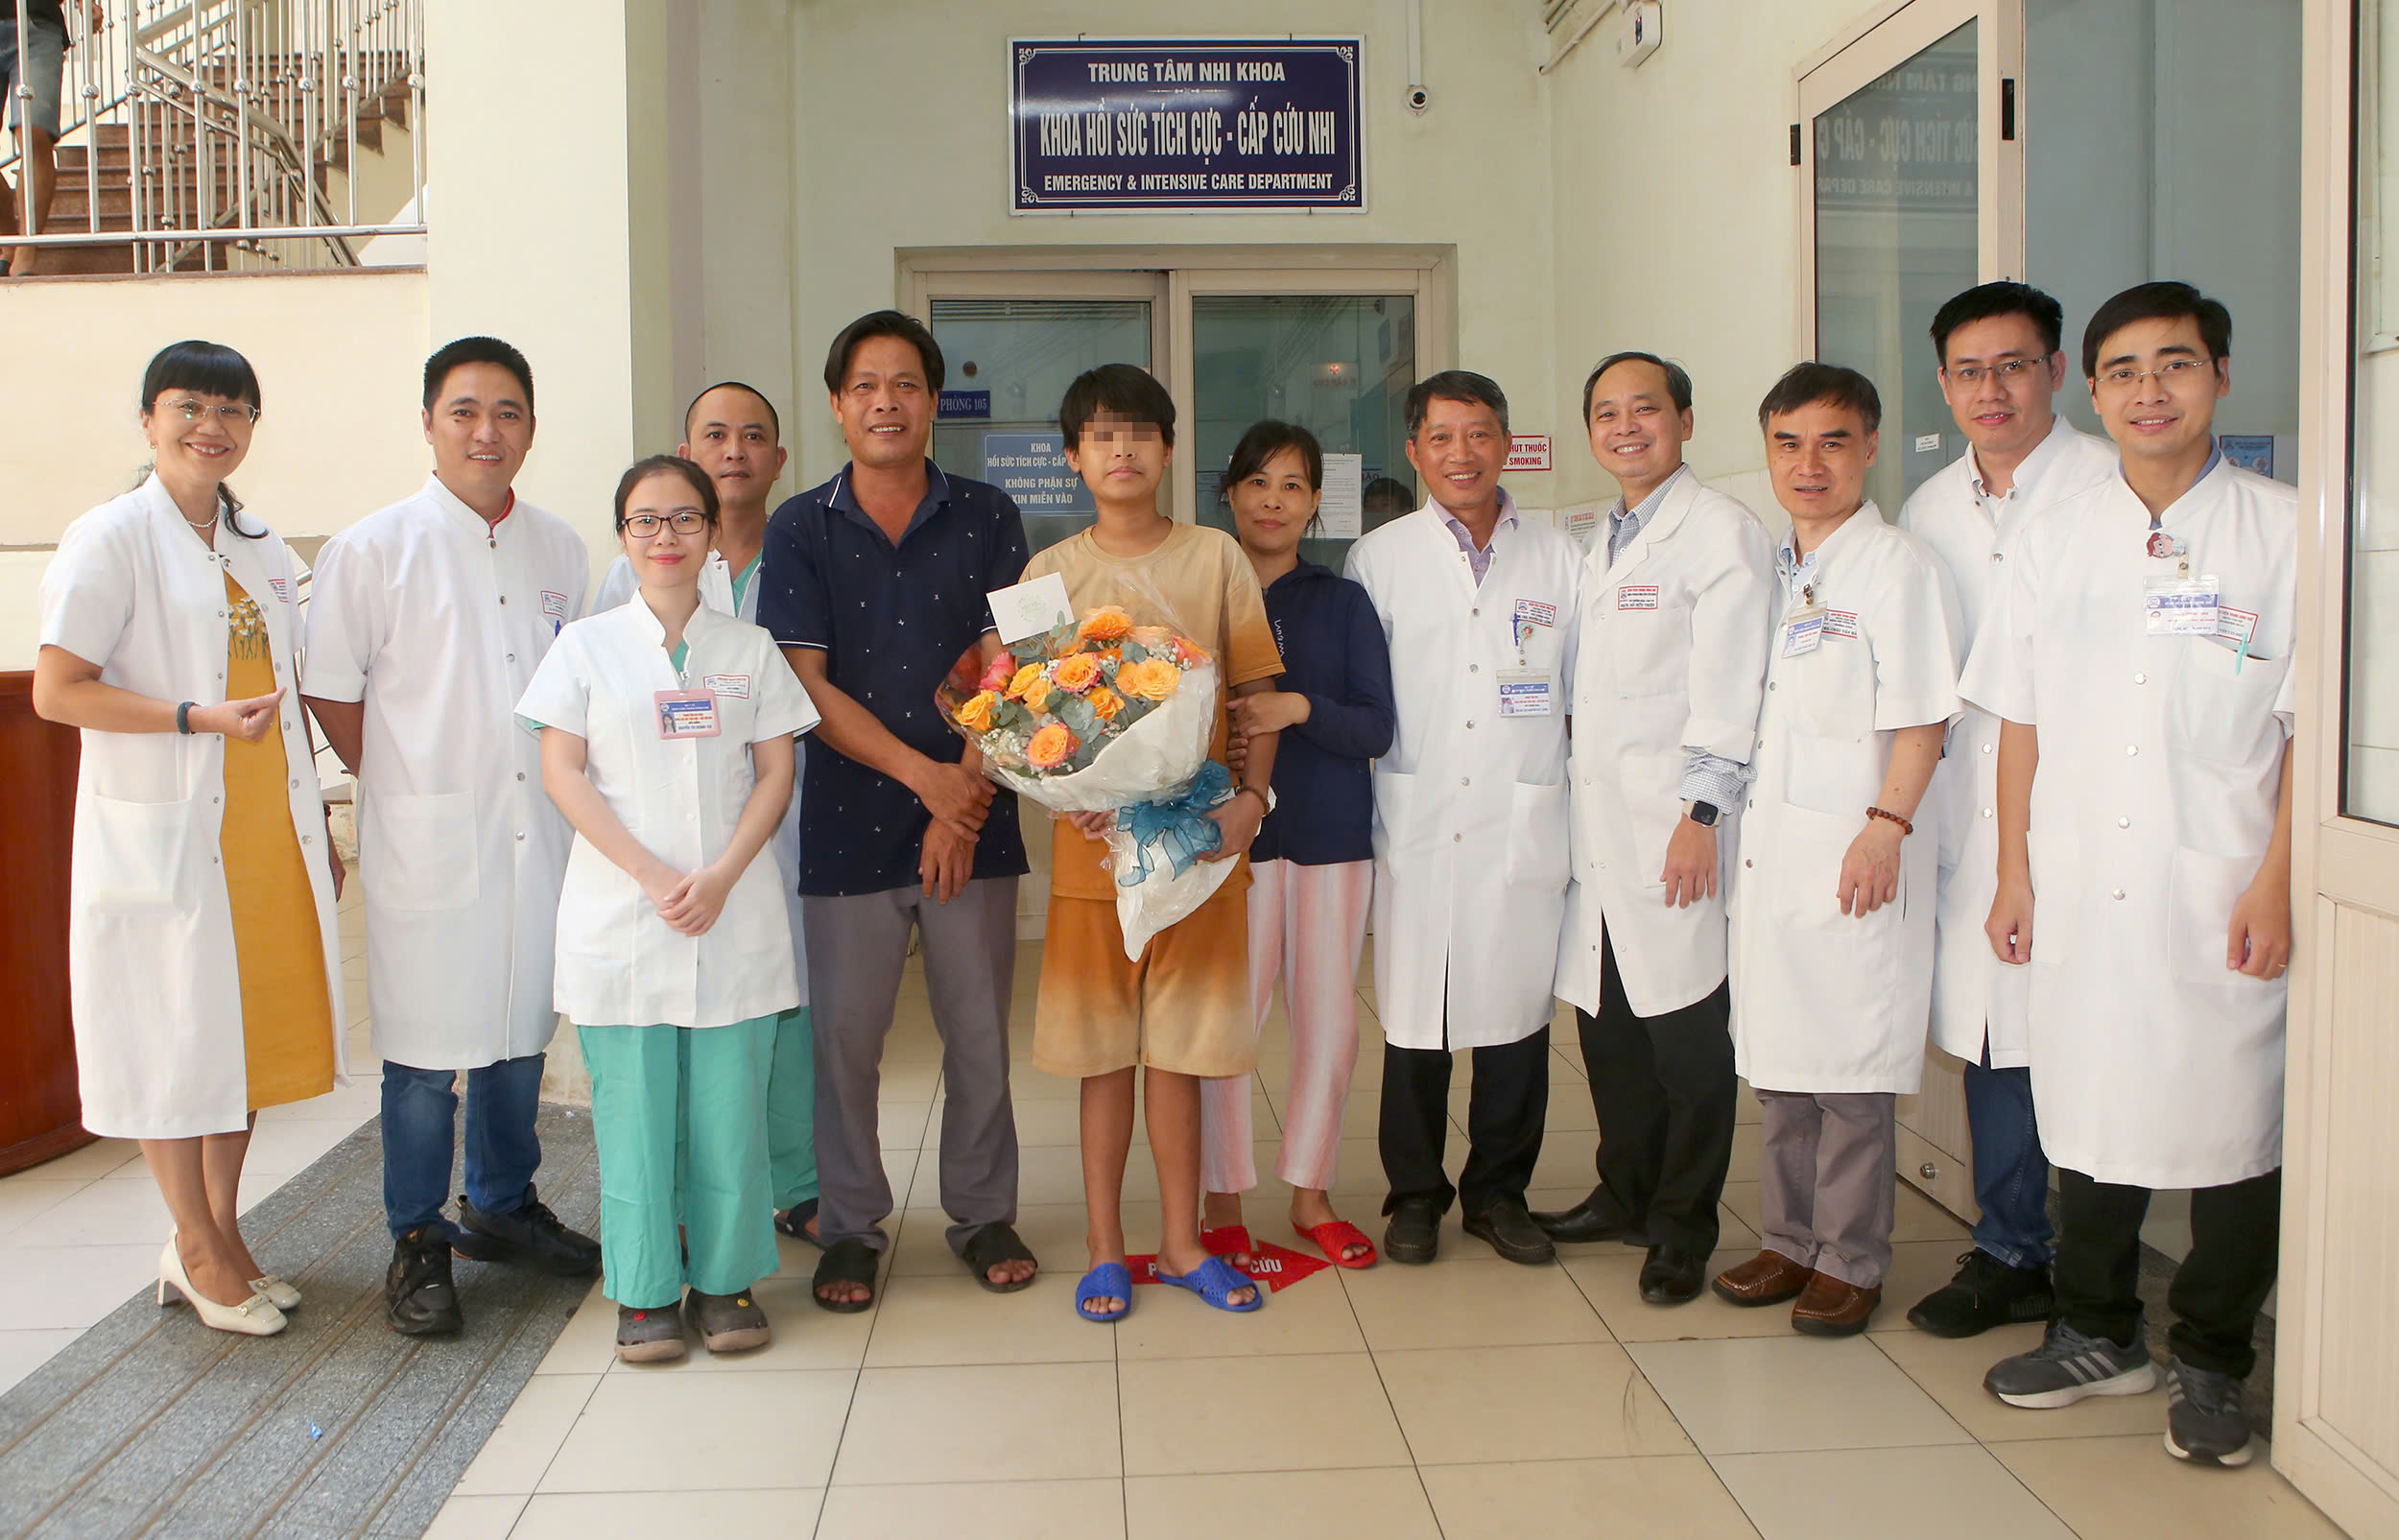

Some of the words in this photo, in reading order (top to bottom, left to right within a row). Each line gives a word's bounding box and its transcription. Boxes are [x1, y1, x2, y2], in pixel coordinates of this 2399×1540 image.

[1087, 62, 1149, 83] TRUNG
[1153, 59, 1194, 83] TÂM
[1199, 62, 1231, 82] NHI
[1236, 62, 1286, 82] KHOA
[1039, 111, 1082, 156] KHOA
[1085, 97, 1112, 156] HỒI
[1116, 102, 1148, 156] SỨC
[1152, 102, 1187, 156] TÍCH
[1191, 107, 1223, 165] CỰC
[1226, 131, 1233, 141] -
[1237, 95, 1269, 155] CẤP
[1272, 101, 1304, 155] CỨU
[1308, 111, 1336, 155] NHI
[1044, 175, 1123, 191] EMERGENCY
[1127, 175, 1136, 190] &
[1141, 174, 1207, 190] INTENSIVE
[1211, 174, 1245, 190] CARE
[1248, 173, 1333, 190] DEPARTMENT
[940, 395, 971, 412] PHÒNG
[974, 398, 987, 411] 105
[1031, 442, 1052, 453] KHOA
[1525, 440, 1547, 453] THUỐC
[1000, 454, 1015, 467] SỨC
[1016, 454, 1033, 467] TÍCH
[1033, 456, 1047, 469] CỰC
[1052, 452, 1067, 467] CẤP
[1508, 457, 1542, 465] SMOKING
[1005, 477, 1035, 488] KHÔNG
[1038, 476, 1063, 490] PHẬN
[1065, 477, 1079, 490] SỰ
[1012, 494, 1028, 504] XIN
[1030, 490, 1054, 504] MIỄN
[1056, 491, 1073, 504] VÀO
